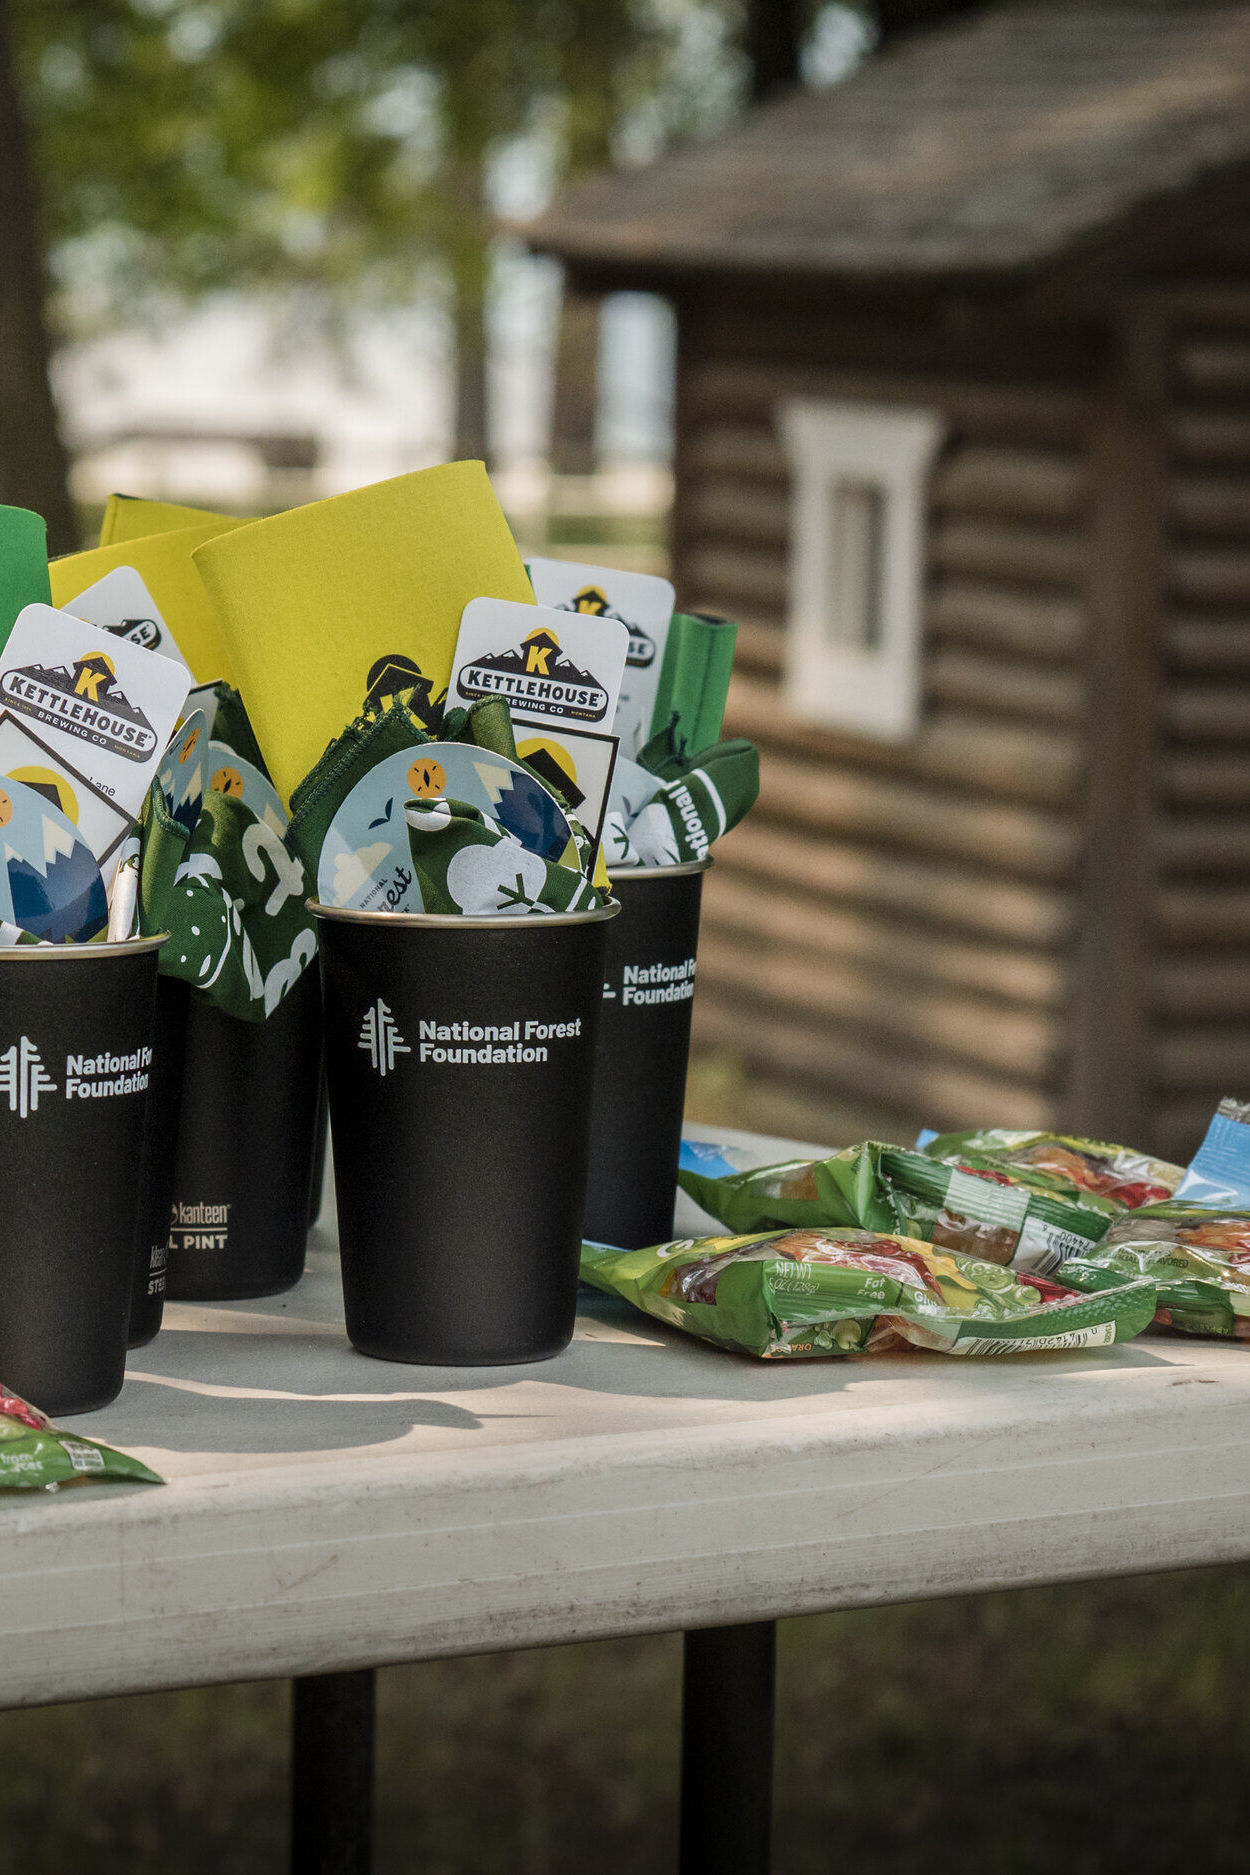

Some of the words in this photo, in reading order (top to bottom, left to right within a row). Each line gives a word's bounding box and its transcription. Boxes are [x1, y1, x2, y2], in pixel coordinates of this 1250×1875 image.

[526, 645, 553, 676] K
[74, 667, 107, 702] K
[468, 669, 600, 707] KETTLEHOUSE
[8, 675, 149, 748] KETTLEHOUSE
[506, 697, 546, 711] REWING
[550, 705, 565, 714] CO
[37, 710, 89, 738] BREWING
[92, 735, 108, 746] CO
[668, 785, 710, 861] ational
[359, 878, 389, 910] NATIONAL
[376, 866, 412, 912] rest
[622, 960, 688, 985] National
[419, 1020, 520, 1042] National
[524, 1018, 582, 1041] Forest
[66, 1048, 141, 1076] National
[419, 1043, 548, 1064] Foundation
[65, 1071, 149, 1099] Foundation
[179, 1201, 229, 1224] kanteen
[183, 1234, 228, 1249] PINT
[775, 1261, 794, 1278] NET
[796, 1263, 813, 1280] WT
[864, 1277, 886, 1289] Fat
[857, 1289, 886, 1300] Free
[770, 1343, 813, 1353] ORAE
